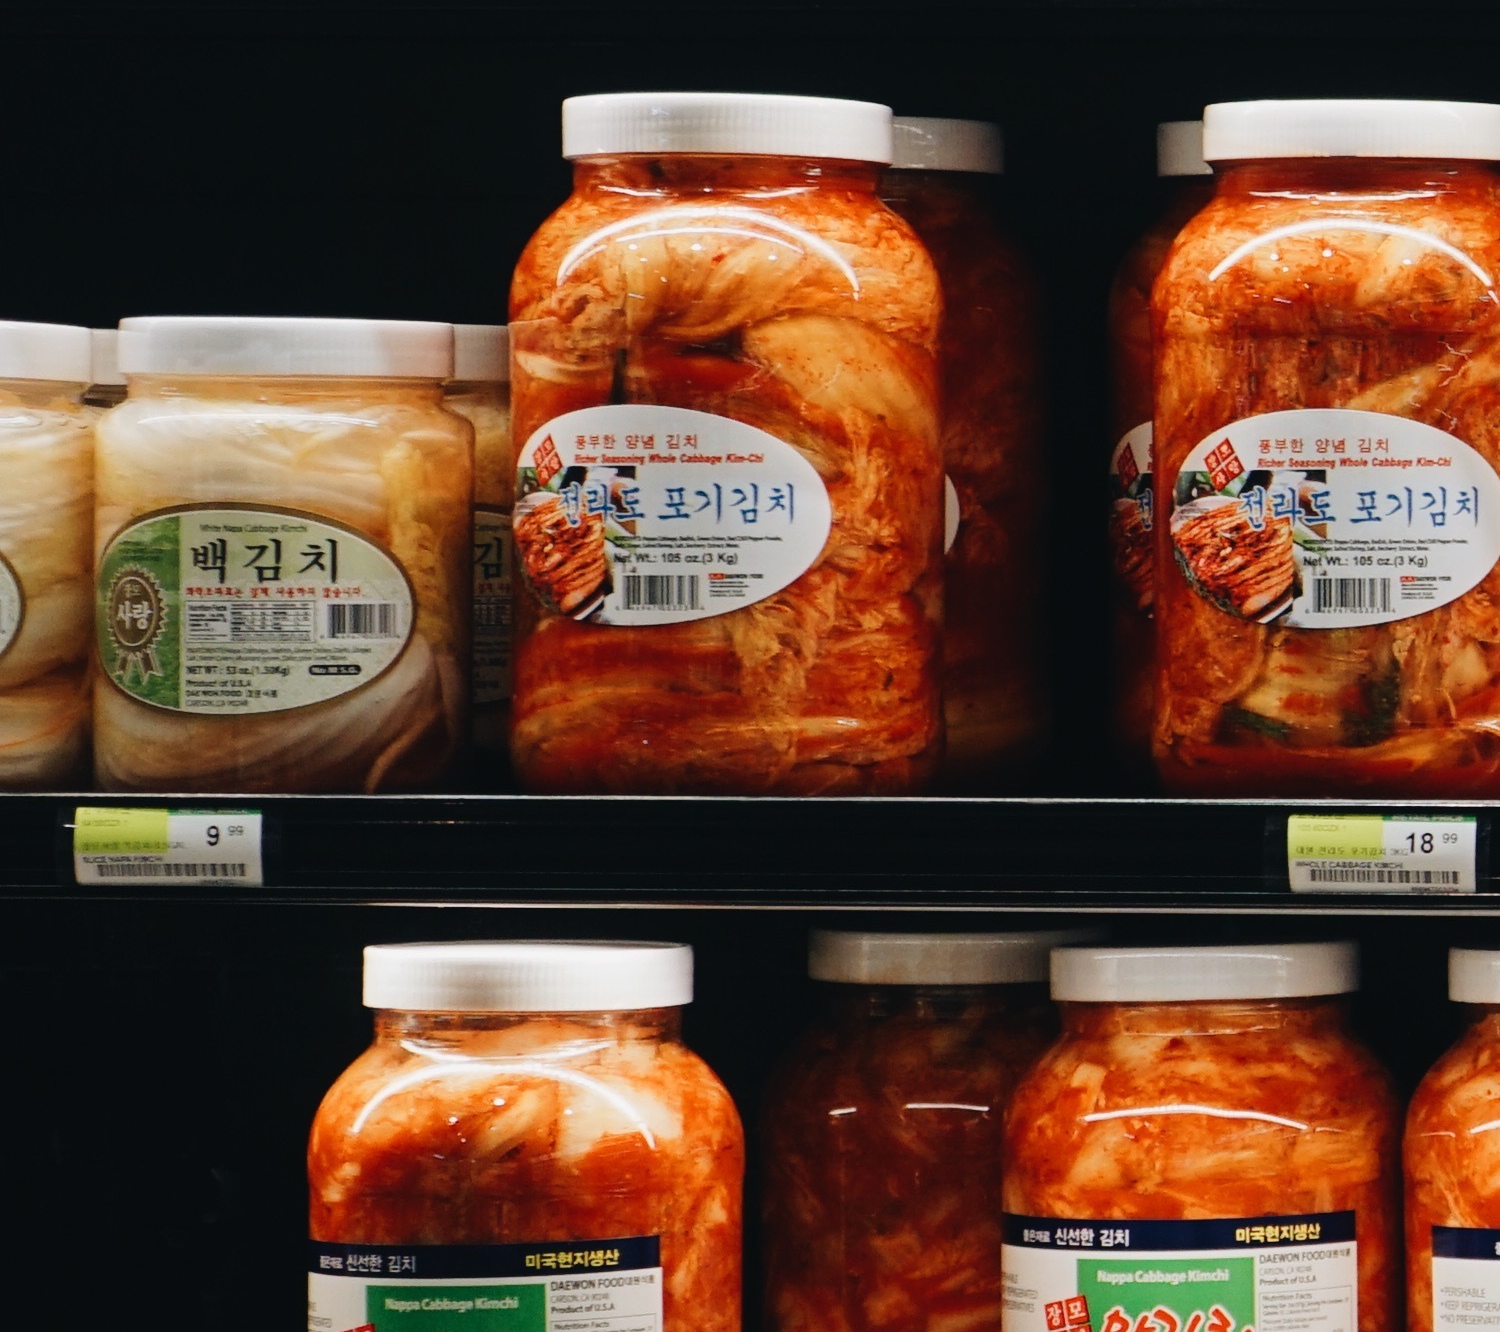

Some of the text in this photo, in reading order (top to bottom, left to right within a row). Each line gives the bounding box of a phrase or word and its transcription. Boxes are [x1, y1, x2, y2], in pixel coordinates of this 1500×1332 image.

[1240, 486, 1480, 530] 전라도 포기김치
[191, 537, 341, 582] 백김치
[205, 824, 244, 847] 9 99
[1406, 833, 1434, 855] 18
[1442, 833, 1457, 844] 99
